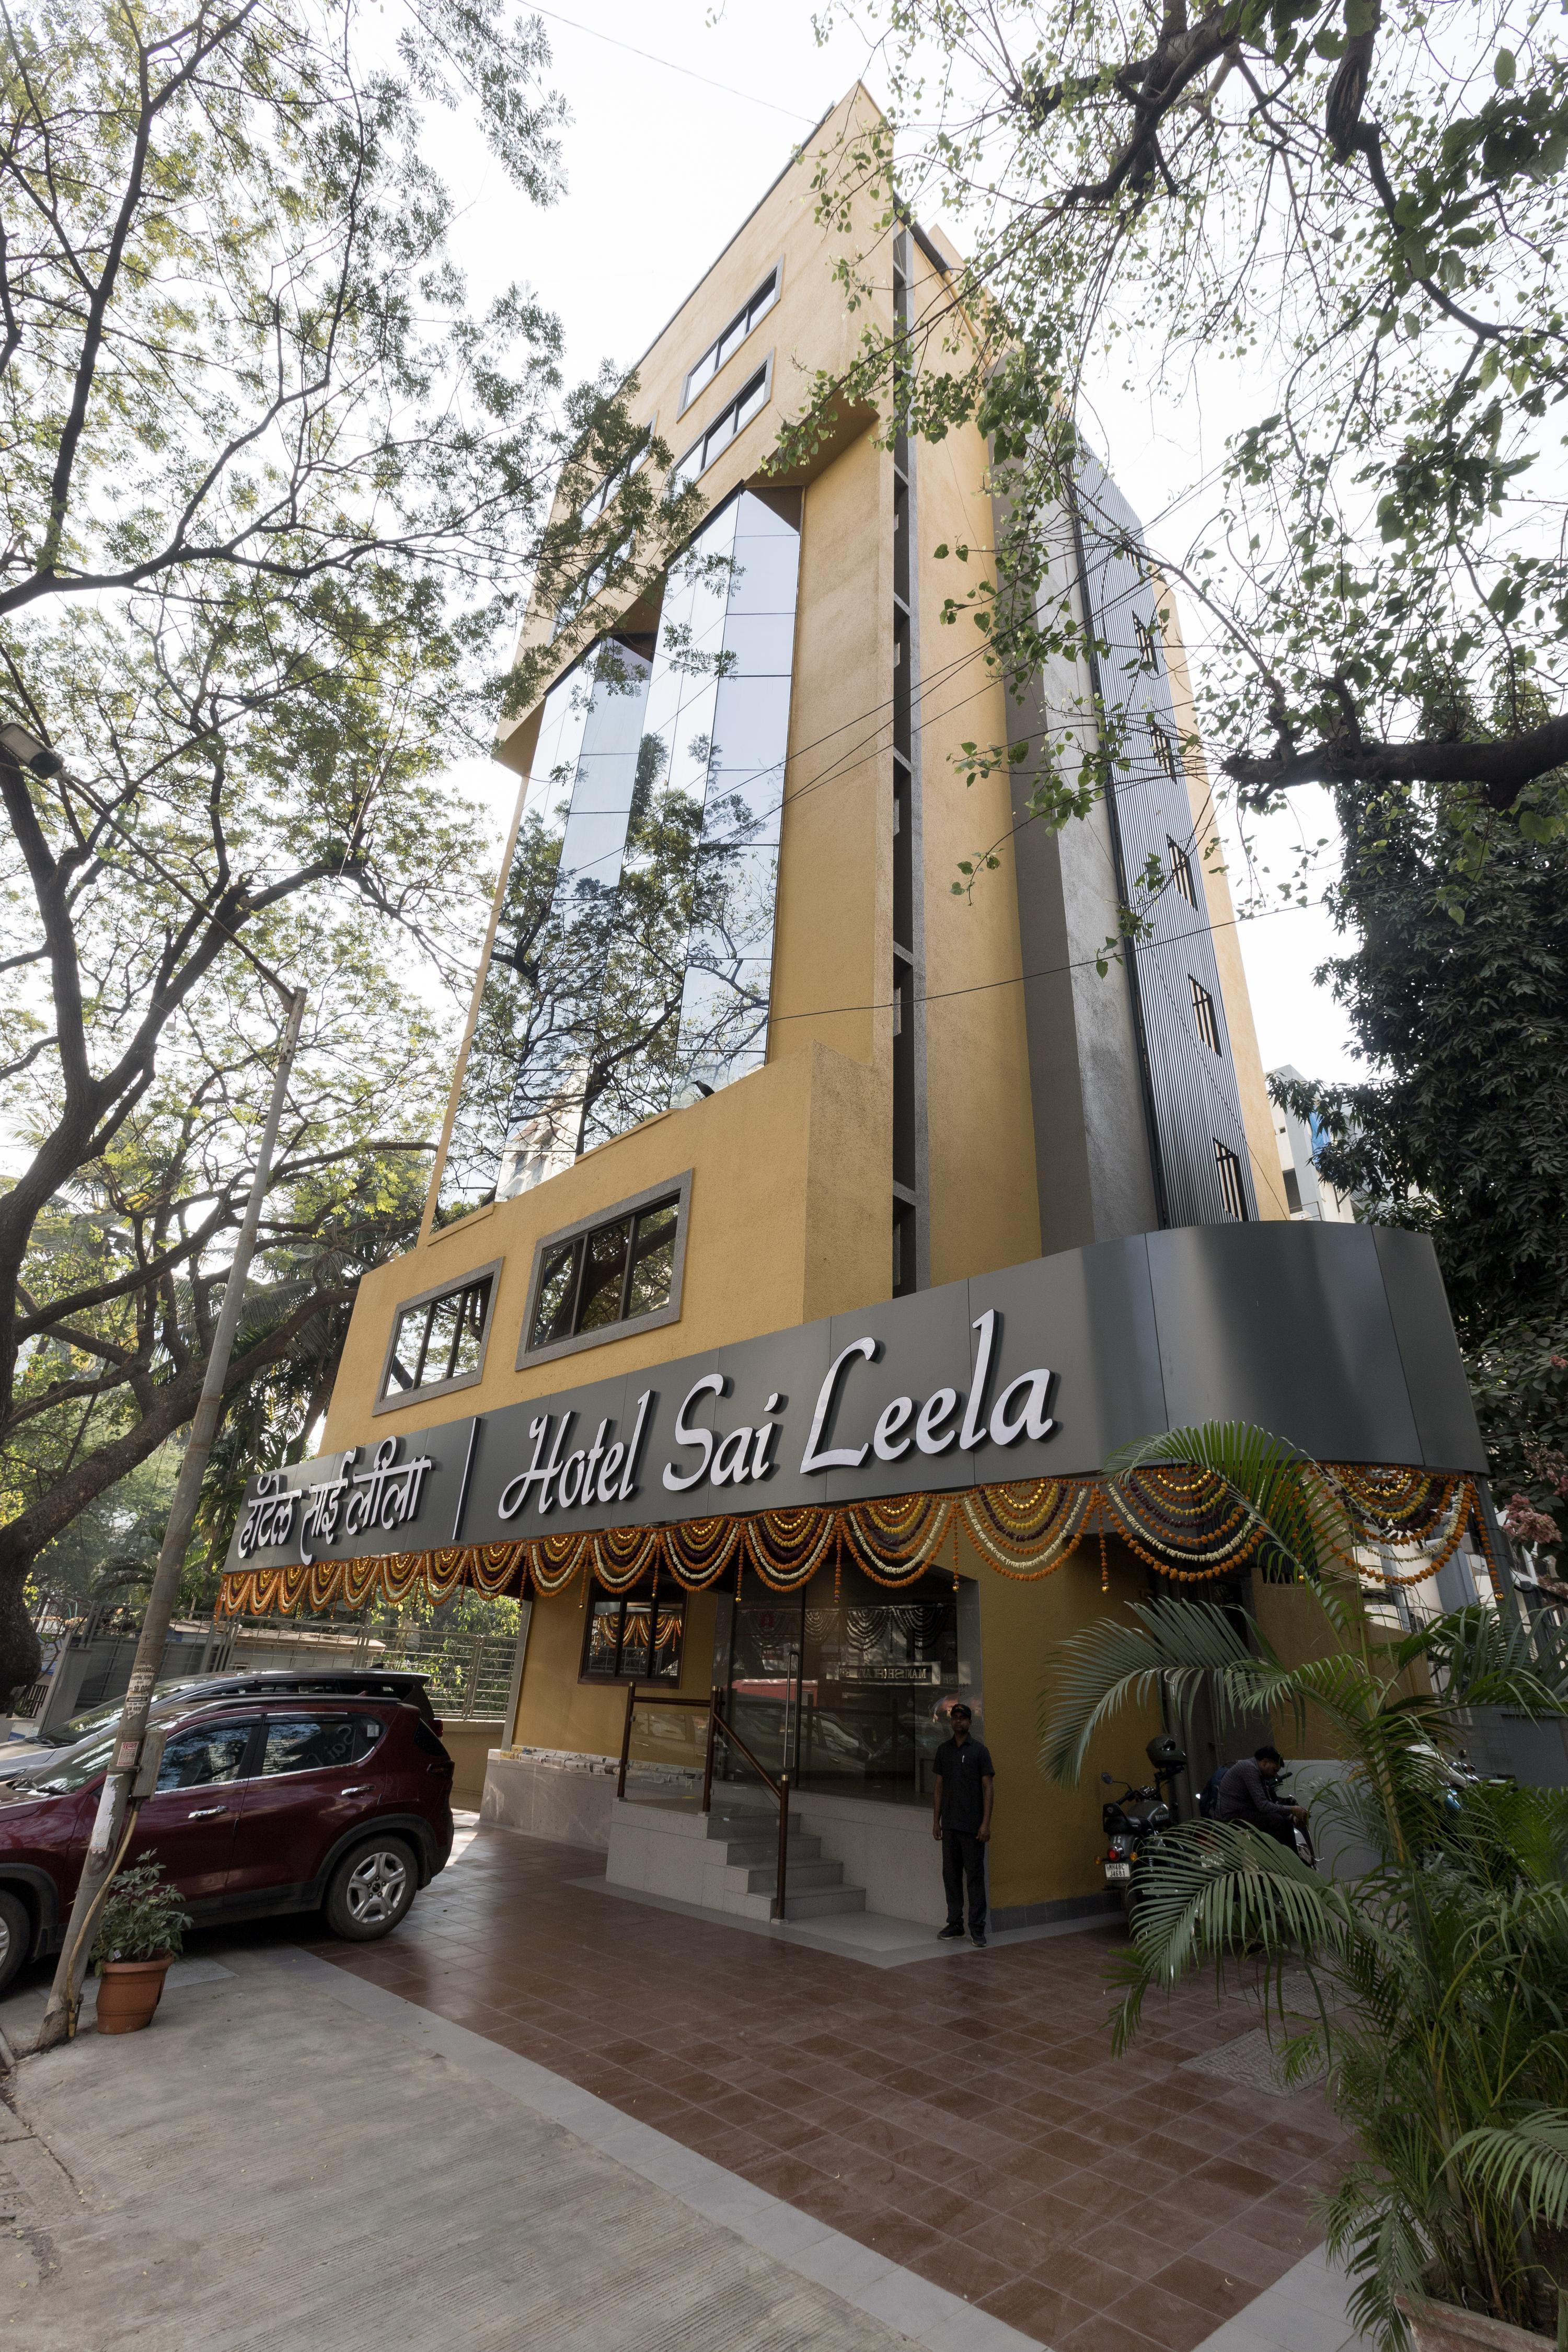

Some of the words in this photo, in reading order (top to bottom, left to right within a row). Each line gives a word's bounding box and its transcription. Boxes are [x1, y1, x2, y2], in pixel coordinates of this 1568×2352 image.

[498, 1389, 653, 1520] Hotel
[662, 1373, 781, 1492] Sai
[800, 1308, 1056, 1475] Leela
[238, 1474, 303, 1559] हॉटेल
[300, 1446, 358, 1566] साई
[346, 1435, 433, 1536] लीला
